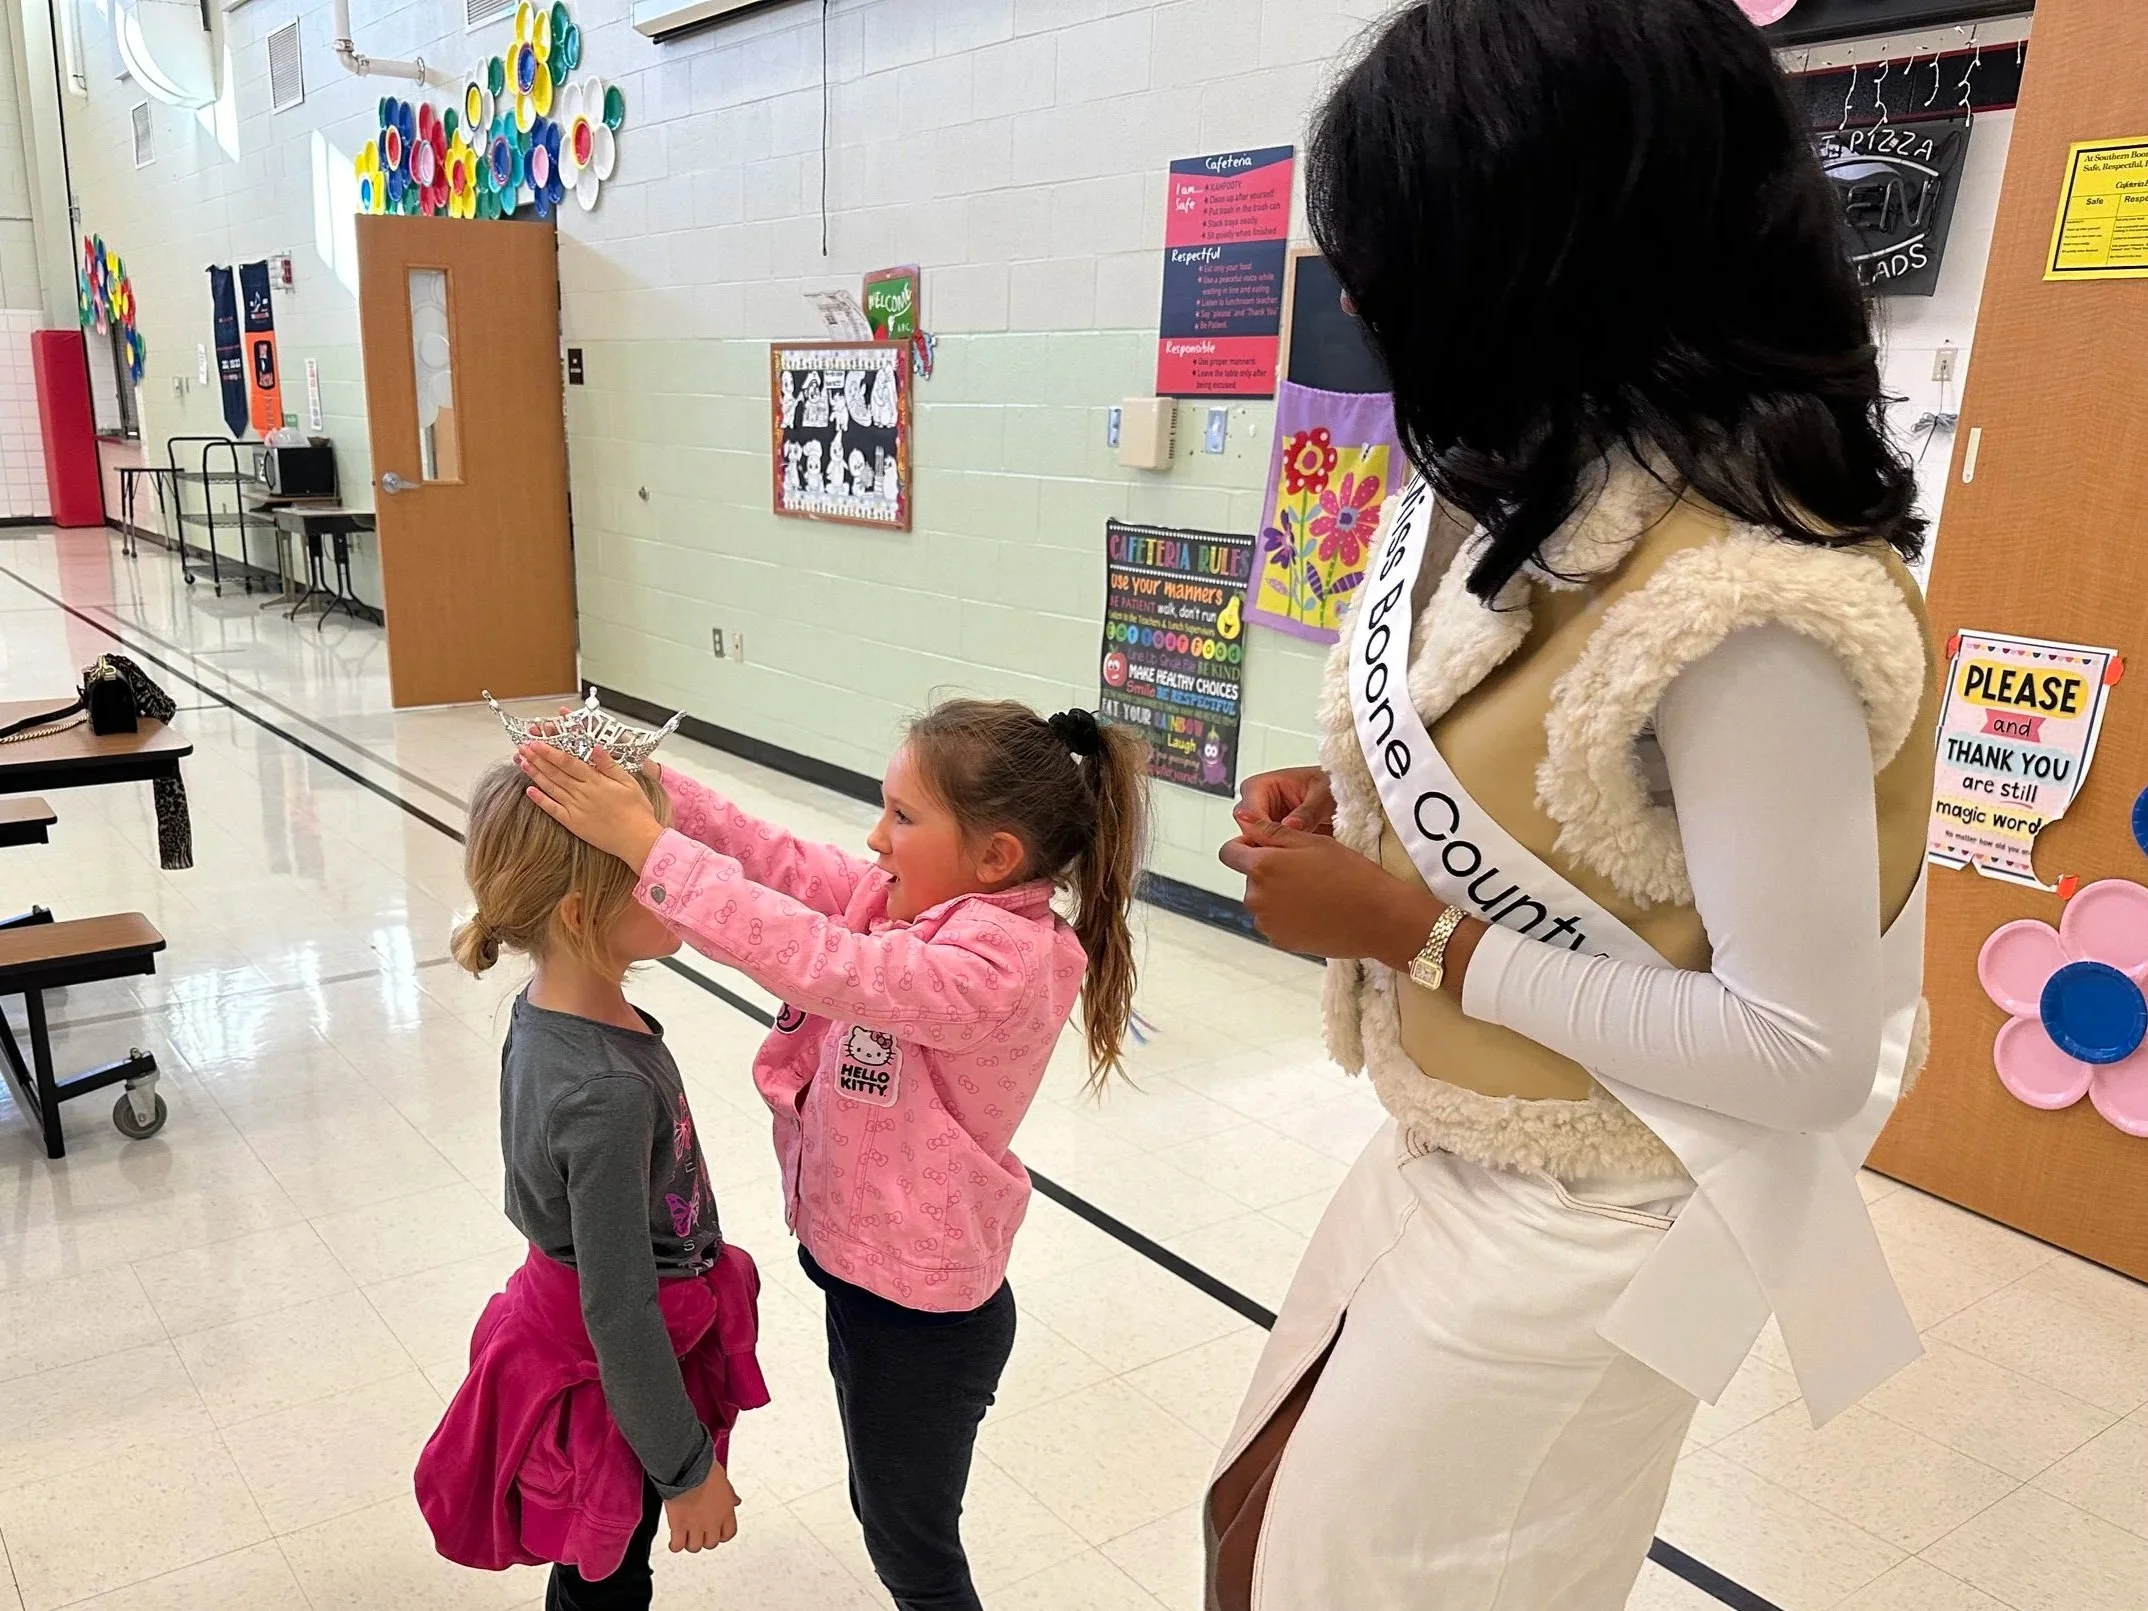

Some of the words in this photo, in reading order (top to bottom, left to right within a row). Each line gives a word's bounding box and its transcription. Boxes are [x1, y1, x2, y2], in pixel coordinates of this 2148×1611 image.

[1850, 130, 1933, 161] PIZZA
[1206, 153, 1252, 173] Cafeteria
[2083, 164, 2101, 172] Safe,
[2103, 161, 2143, 171] Respectful,
[2094, 153, 2130, 161] Southern
[1176, 198, 1196, 213] Safe
[1210, 196, 1226, 204] Clean
[1226, 195, 1234, 203] up
[1235, 192, 1248, 201] after
[2086, 197, 2104, 205] Safe
[1208, 208, 1220, 216] Put
[1220, 206, 1234, 214] trash
[1242, 204, 1252, 212] the
[1252, 203, 1268, 212] trash
[1208, 220, 1222, 228] Stack
[1224, 218, 1238, 228] trays
[1216, 230, 1234, 240] quietly
[1171, 246, 1221, 265] Respectful
[1204, 264, 1212, 272] Eat
[1214, 265, 1224, 273] only
[1226, 264, 1238, 272] your
[1202, 276, 1213, 284] Use
[1219, 275, 1242, 284] peaceful
[1243, 274, 1257, 282] voice
[868, 282, 912, 312] WELCOME
[1202, 288, 1221, 296] waiting
[1240, 286, 1250, 294] and
[1225, 298, 1254, 306] lunchroom
[1200, 310, 1210, 318] Say
[1166, 340, 1216, 358] Responsible
[1210, 358, 1228, 367] proper
[1240, 370, 1252, 378] only
[1253, 368, 1267, 376] after
[1196, 382, 1212, 390] being
[1380, 472, 1427, 581] Miss
[1109, 534, 1190, 570] CAFETERIA
[1198, 545, 1250, 578] RULES
[1132, 576, 1161, 596] your
[1164, 582, 1224, 605] manners
[1109, 596, 1119, 607] BE
[1120, 597, 1156, 612] PATIENT
[1179, 605, 1200, 620] don't
[1202, 612, 1216, 622] run
[1212, 664, 1240, 680] KIND
[1365, 579, 1411, 780] Boone
[1128, 664, 1156, 682] MAKE
[1156, 670, 1195, 691] HEALTHY
[1196, 678, 1238, 700] CHOICES
[1964, 665, 2081, 714] PLEASE
[1127, 681, 1155, 697] Smile
[1156, 686, 1170, 700] BE
[1170, 690, 1236, 716] RESPECTFUL
[1102, 698, 1120, 716] EAT
[1123, 704, 1151, 725] YOUR
[1994, 718, 2032, 737] and
[1168, 734, 1196, 754] Laugh
[1948, 738, 2014, 772] THANK
[2022, 753, 2070, 781] YOU
[1962, 776, 1994, 793] are
[2001, 782, 2038, 803] still
[1936, 800, 1986, 824] magic
[1955, 834, 1976, 842] matter
[1980, 838, 1992, 846] how
[2008, 846, 2019, 854] you
[841, 1064, 890, 1083] HELLO
